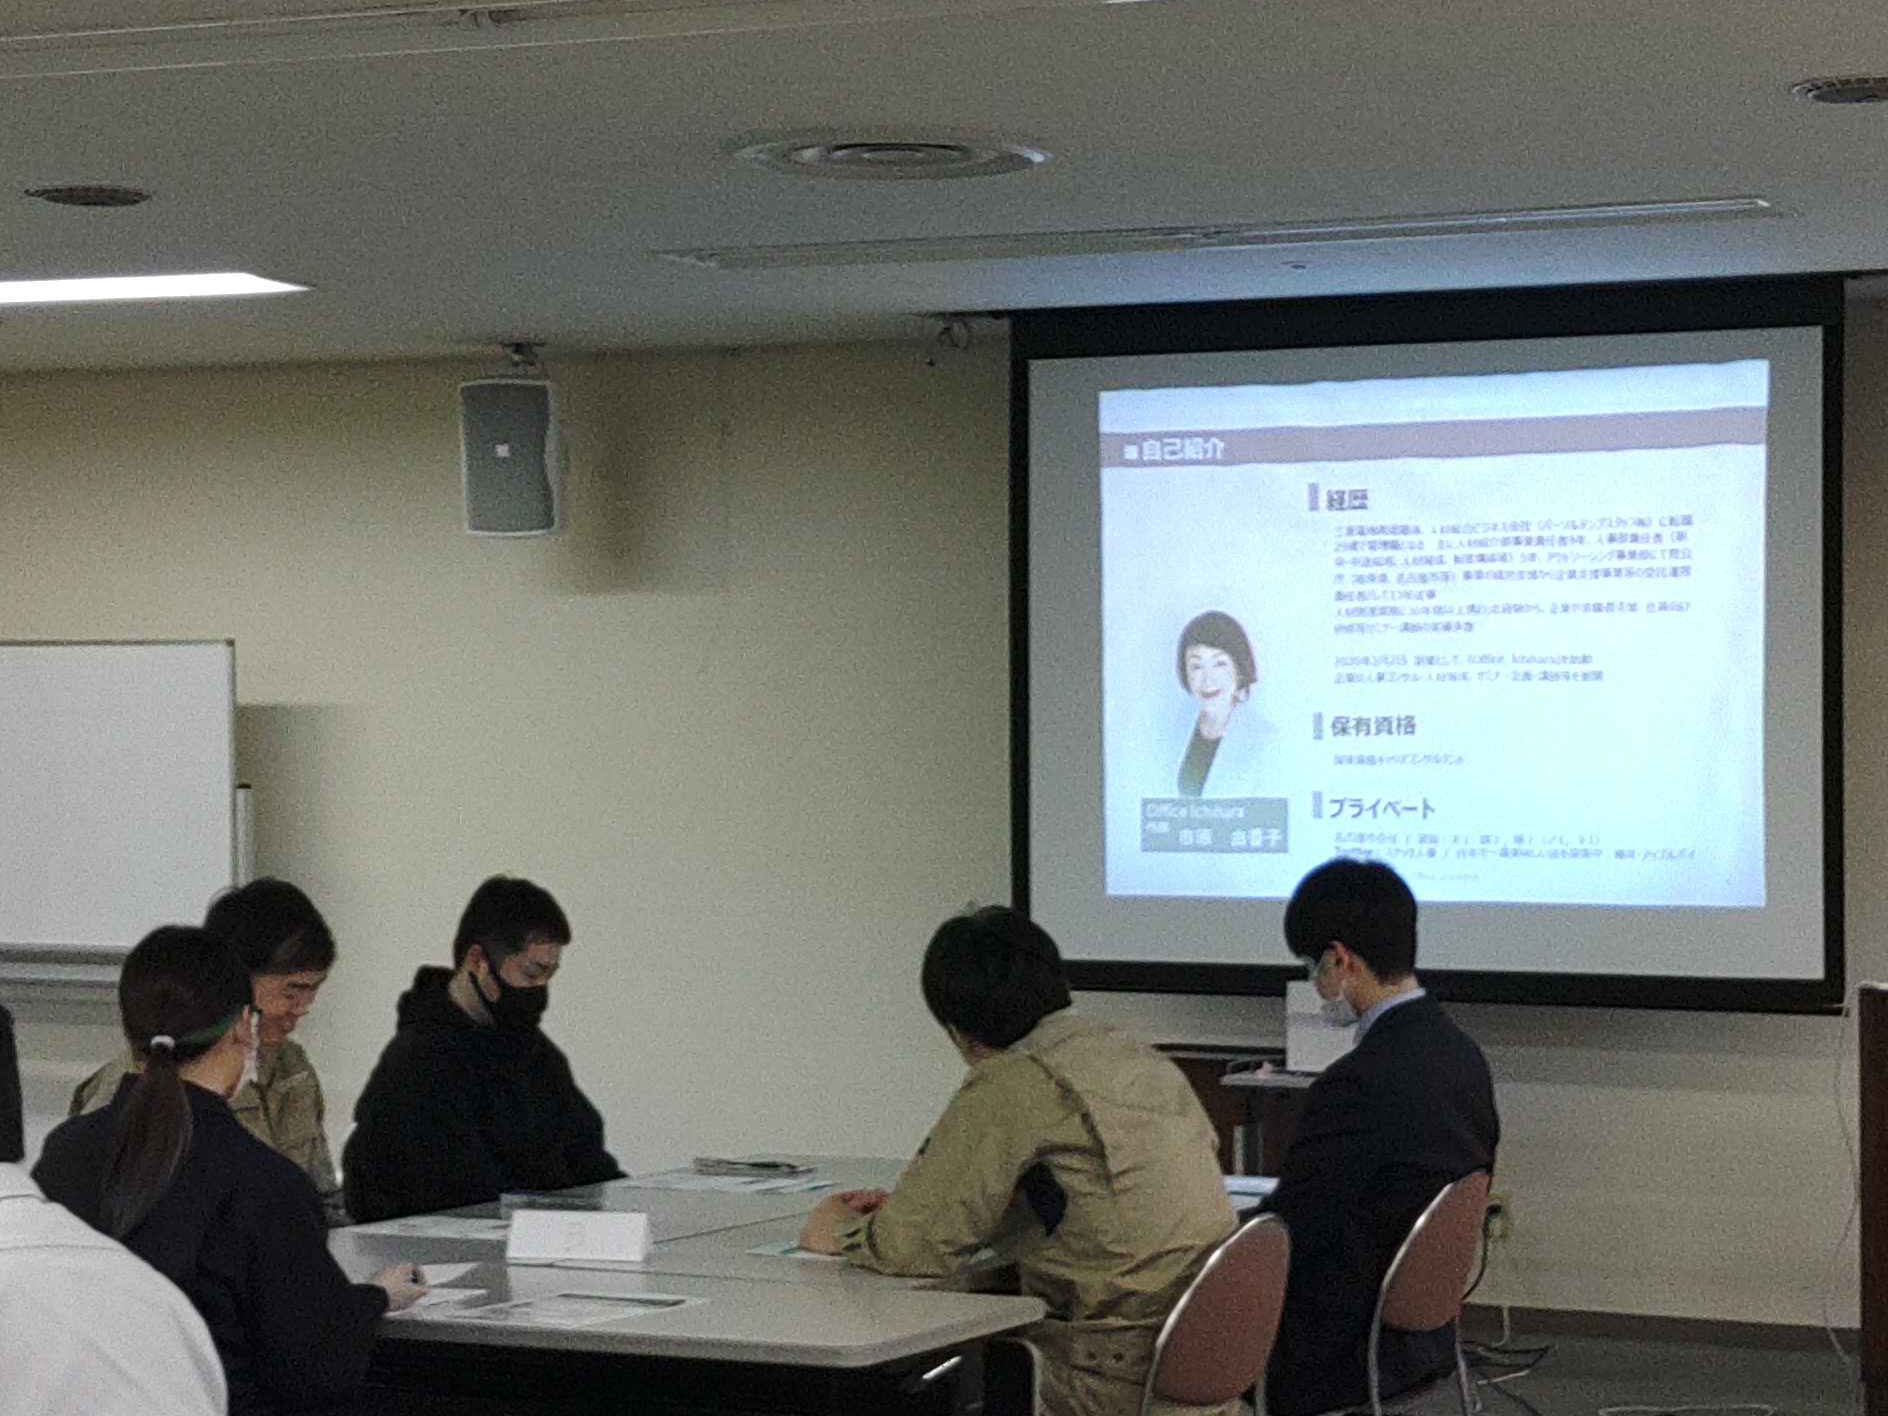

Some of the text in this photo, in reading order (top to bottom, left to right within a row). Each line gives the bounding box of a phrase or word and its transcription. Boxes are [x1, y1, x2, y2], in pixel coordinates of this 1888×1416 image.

[1142, 437, 1225, 461] 自己紹介
[1331, 715, 1416, 737] 保有資格
[1329, 797, 1436, 820] プライベート
